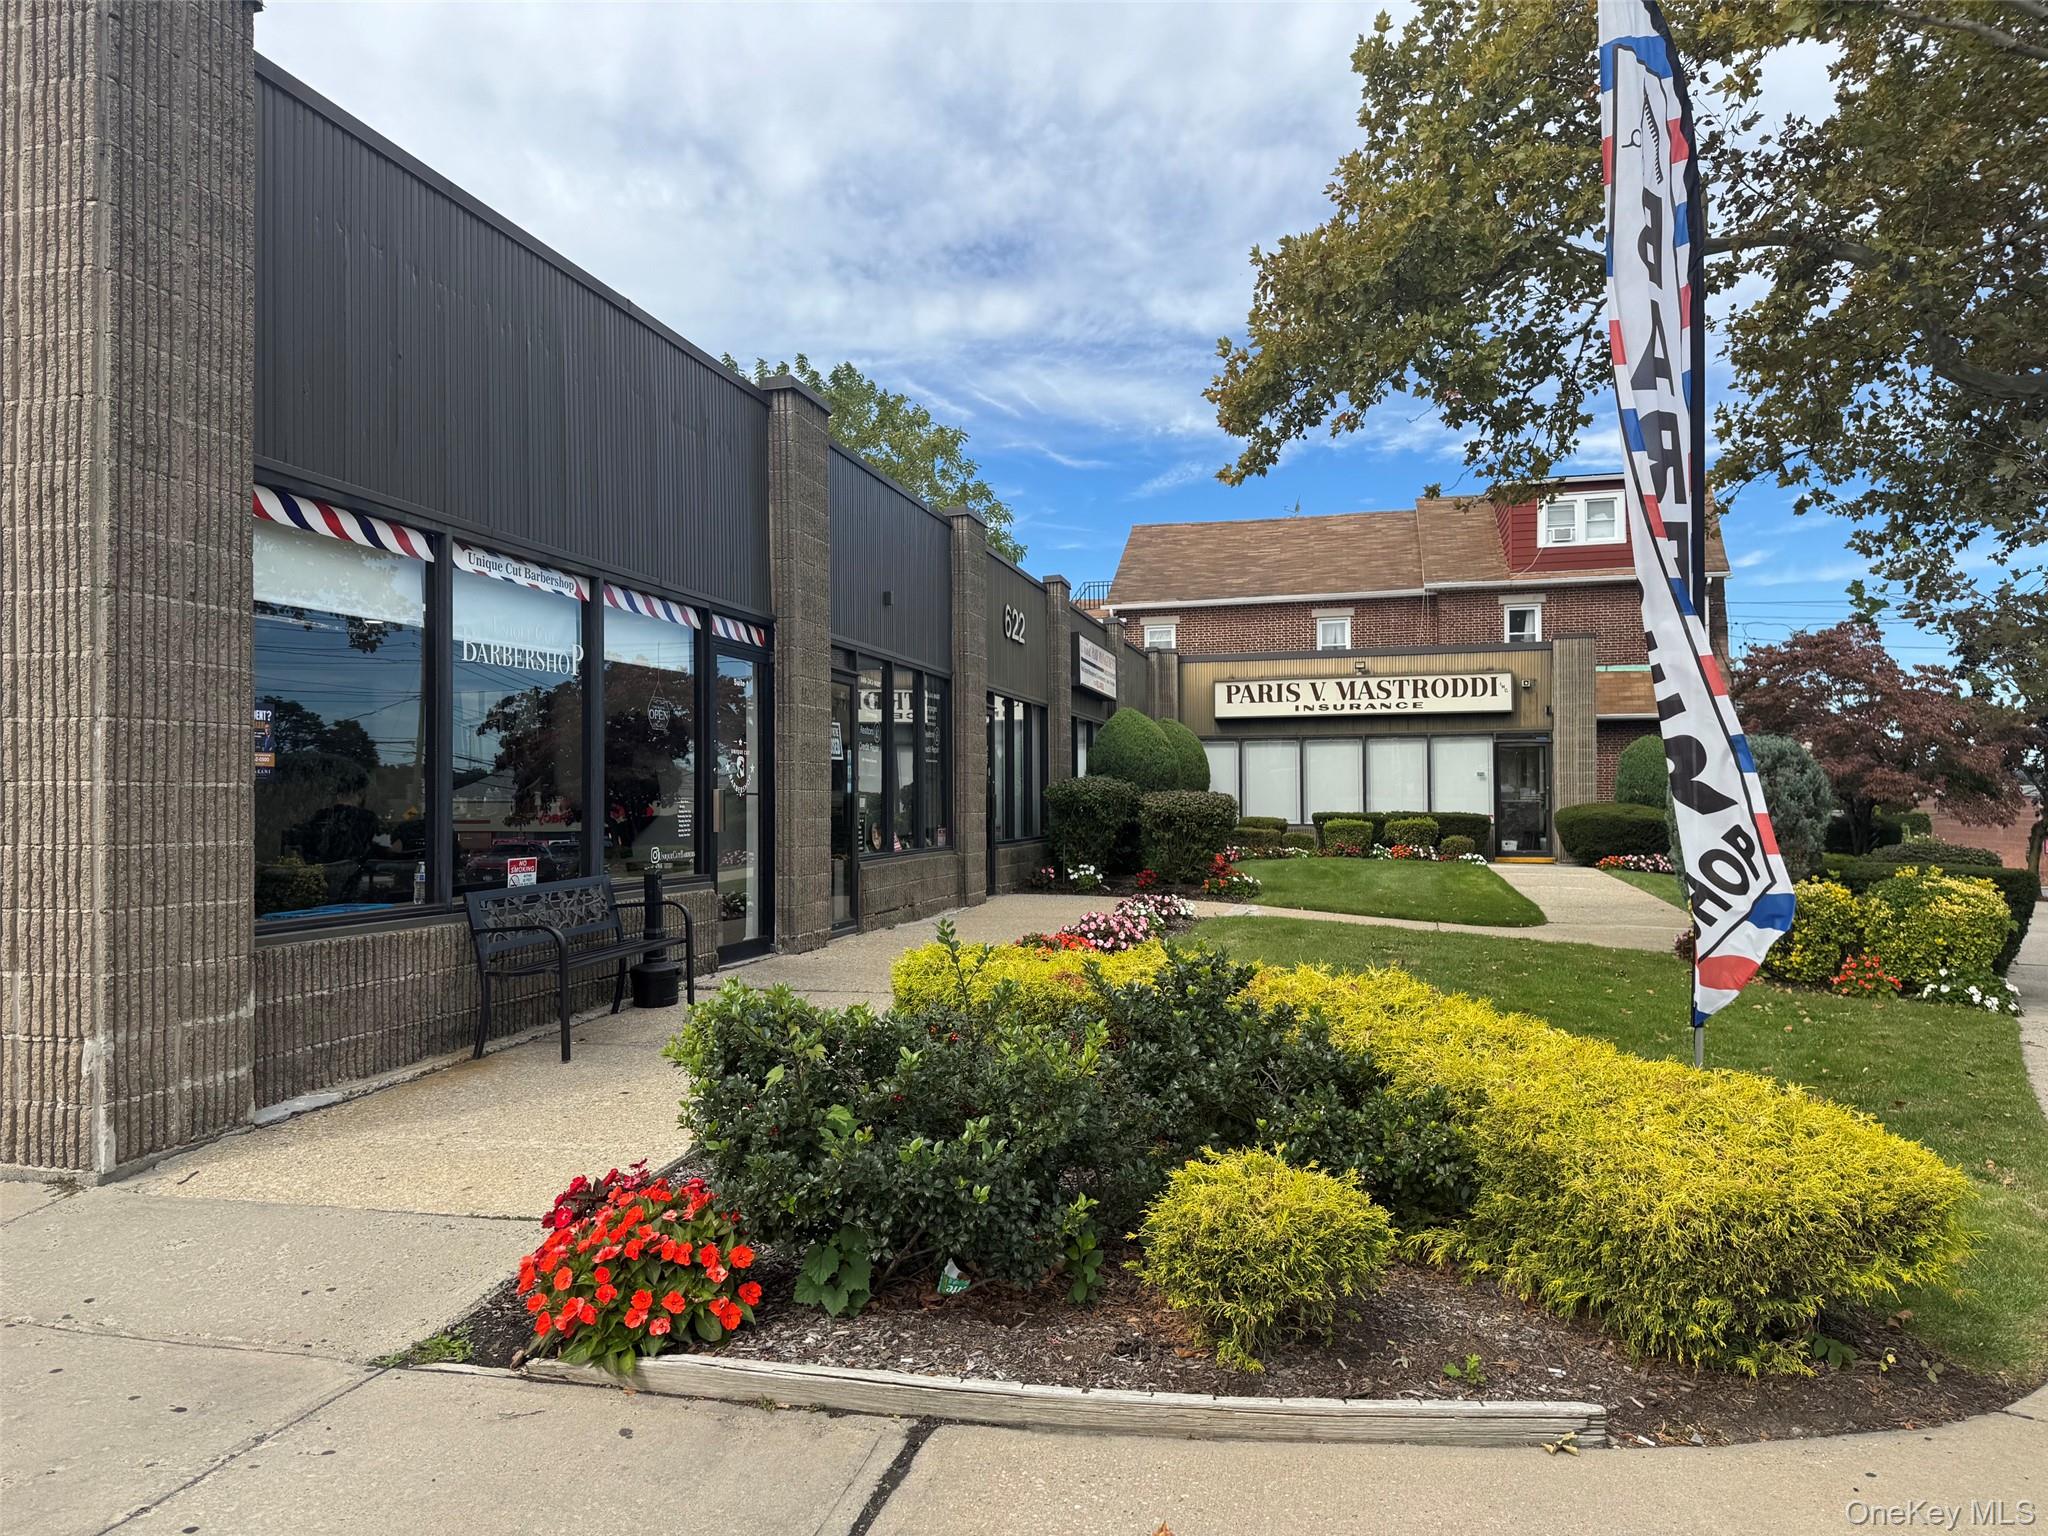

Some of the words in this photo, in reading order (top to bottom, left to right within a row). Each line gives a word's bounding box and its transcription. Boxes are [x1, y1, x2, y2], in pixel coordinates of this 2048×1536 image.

[467, 552, 503, 572] Unique
[505, 562, 521, 577] Cut
[524, 567, 574, 592] Barbershop
[1004, 603, 1026, 645] 622
[461, 633, 584, 676] BARBERSHOP
[1225, 683, 1301, 704] PARIS
[1309, 681, 1327, 701] V.
[1335, 676, 1498, 701] MASTRODDI
[1294, 701, 1424, 712] INSURANCE
[649, 708, 669, 720] OPEN
[510, 866, 535, 874] SMOKING
[1685, 823, 1761, 940] HOP
